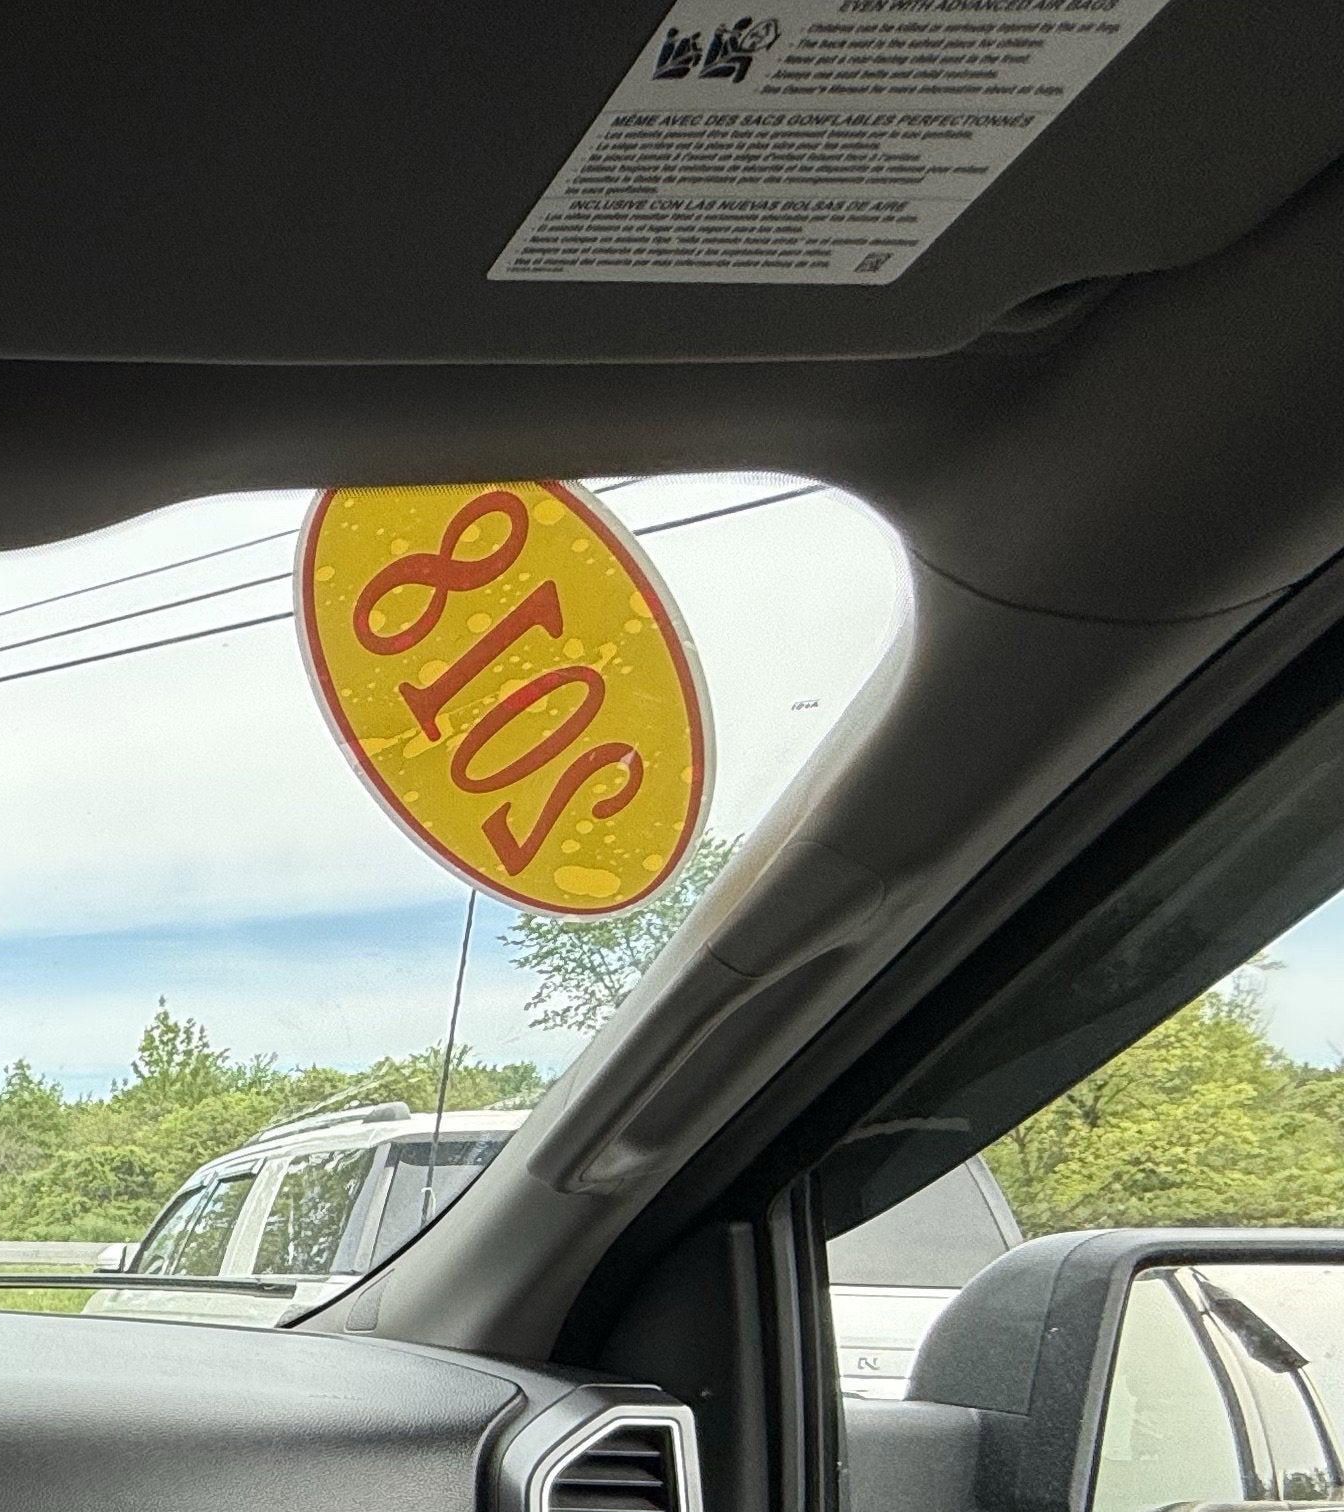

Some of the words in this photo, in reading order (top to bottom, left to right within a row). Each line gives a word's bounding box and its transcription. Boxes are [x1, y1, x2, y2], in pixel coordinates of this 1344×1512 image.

[610, 113, 659, 126] MÊME
[658, 114, 699, 126] AVEC
[739, 115, 787, 126] SACS
[786, 114, 896, 126] GONFLABLES
[898, 114, 1035, 128] PERFECTIONNÉS
[570, 201, 644, 211] INCLUSIVE
[717, 201, 778, 212] NUEVAS
[780, 201, 844, 212] BOLSAS
[870, 202, 908, 212] AIRE
